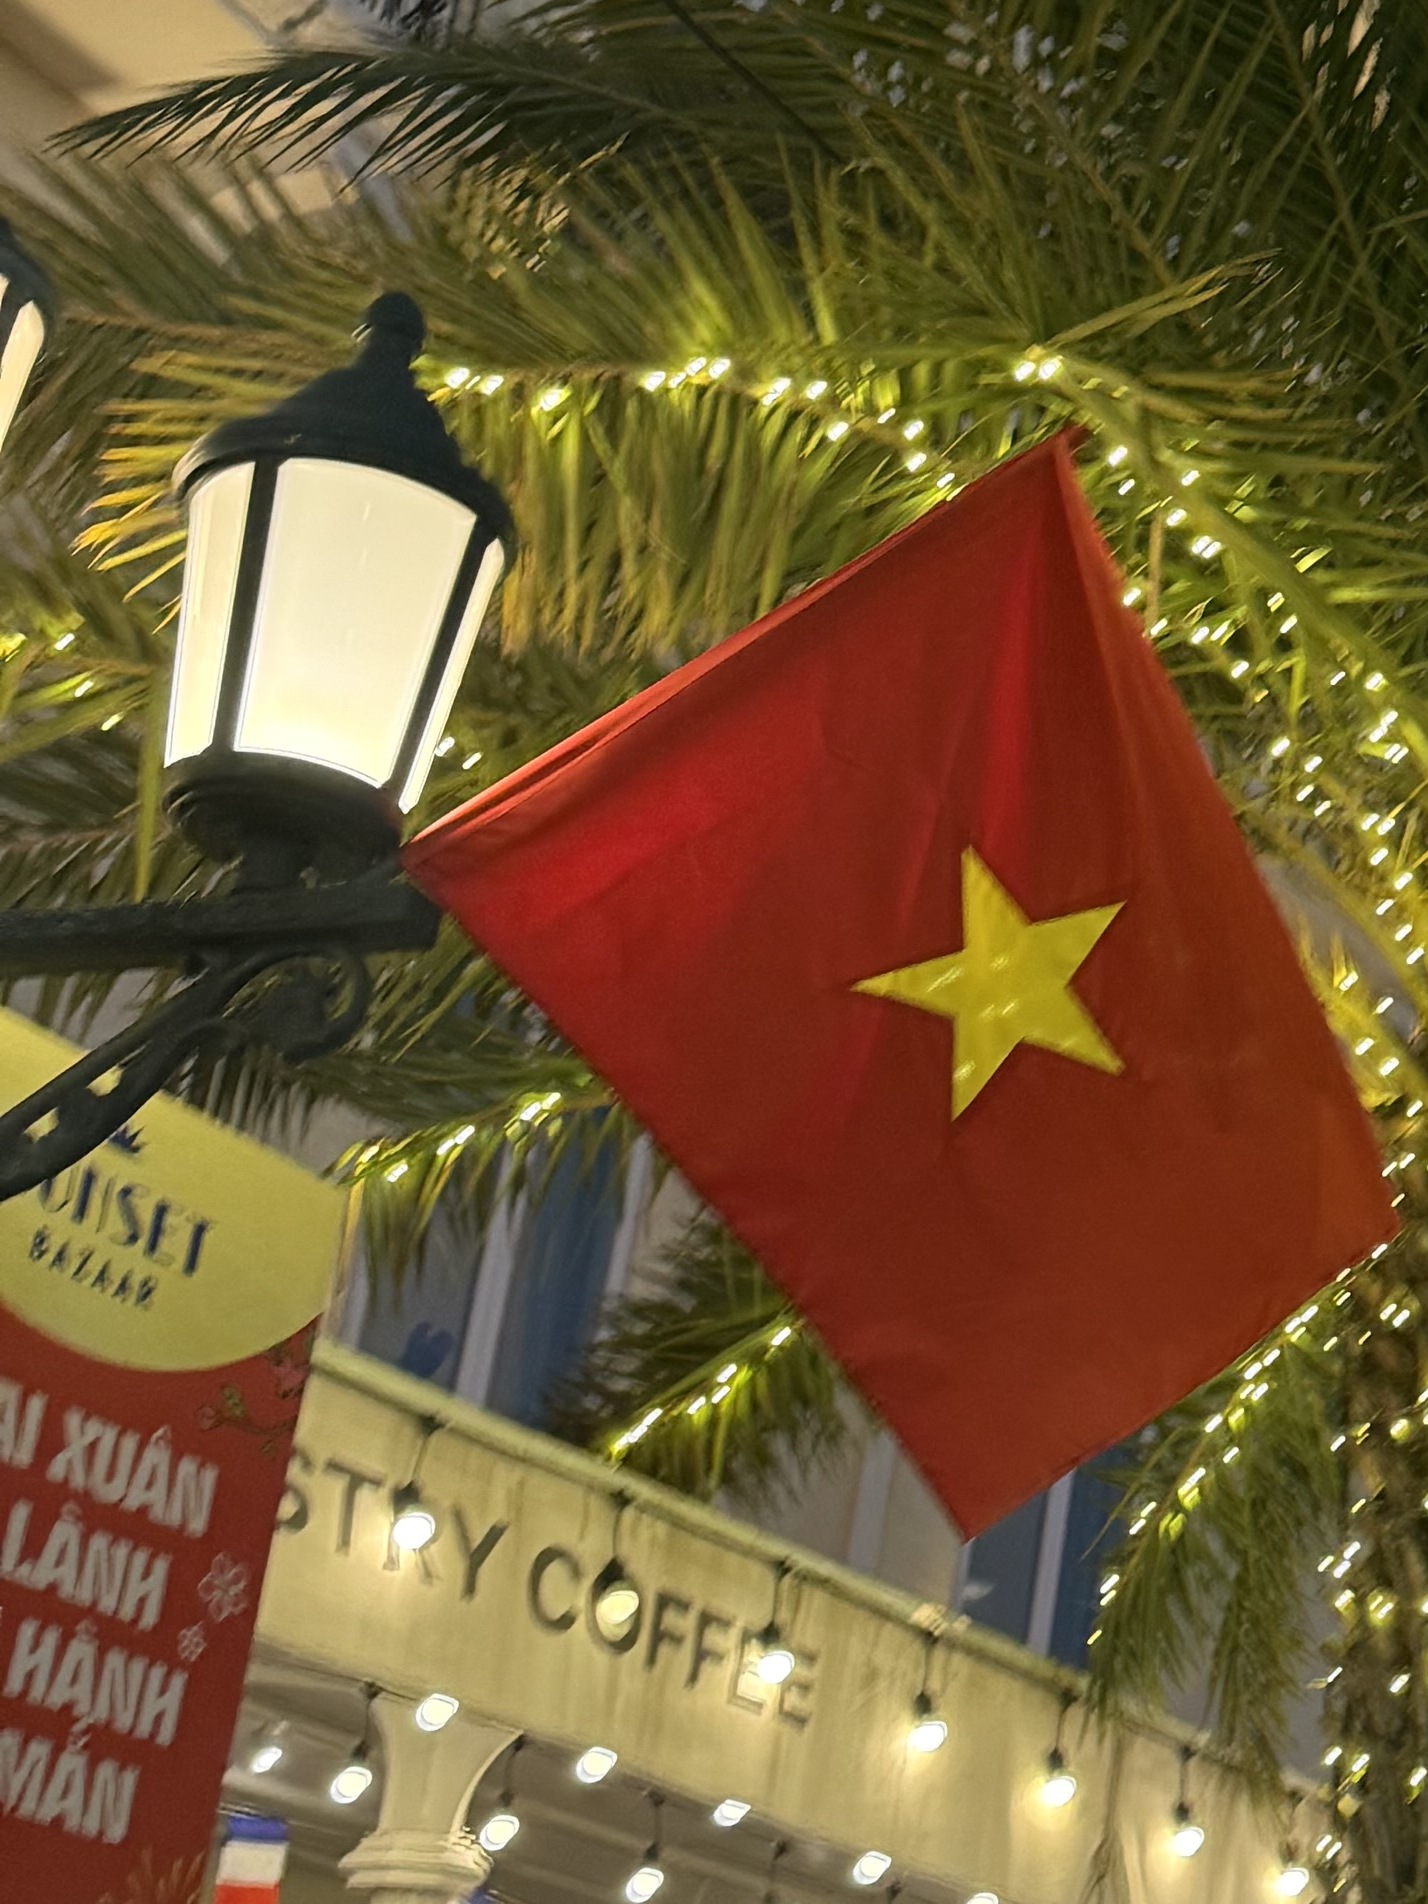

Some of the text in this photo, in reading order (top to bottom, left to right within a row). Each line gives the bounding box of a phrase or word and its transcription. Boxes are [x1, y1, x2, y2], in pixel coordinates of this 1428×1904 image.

[28, 1223, 159, 1311] BAZAAR
[38, 1163, 213, 1279] UNSET
[45, 1405, 219, 1538] XUÂN
